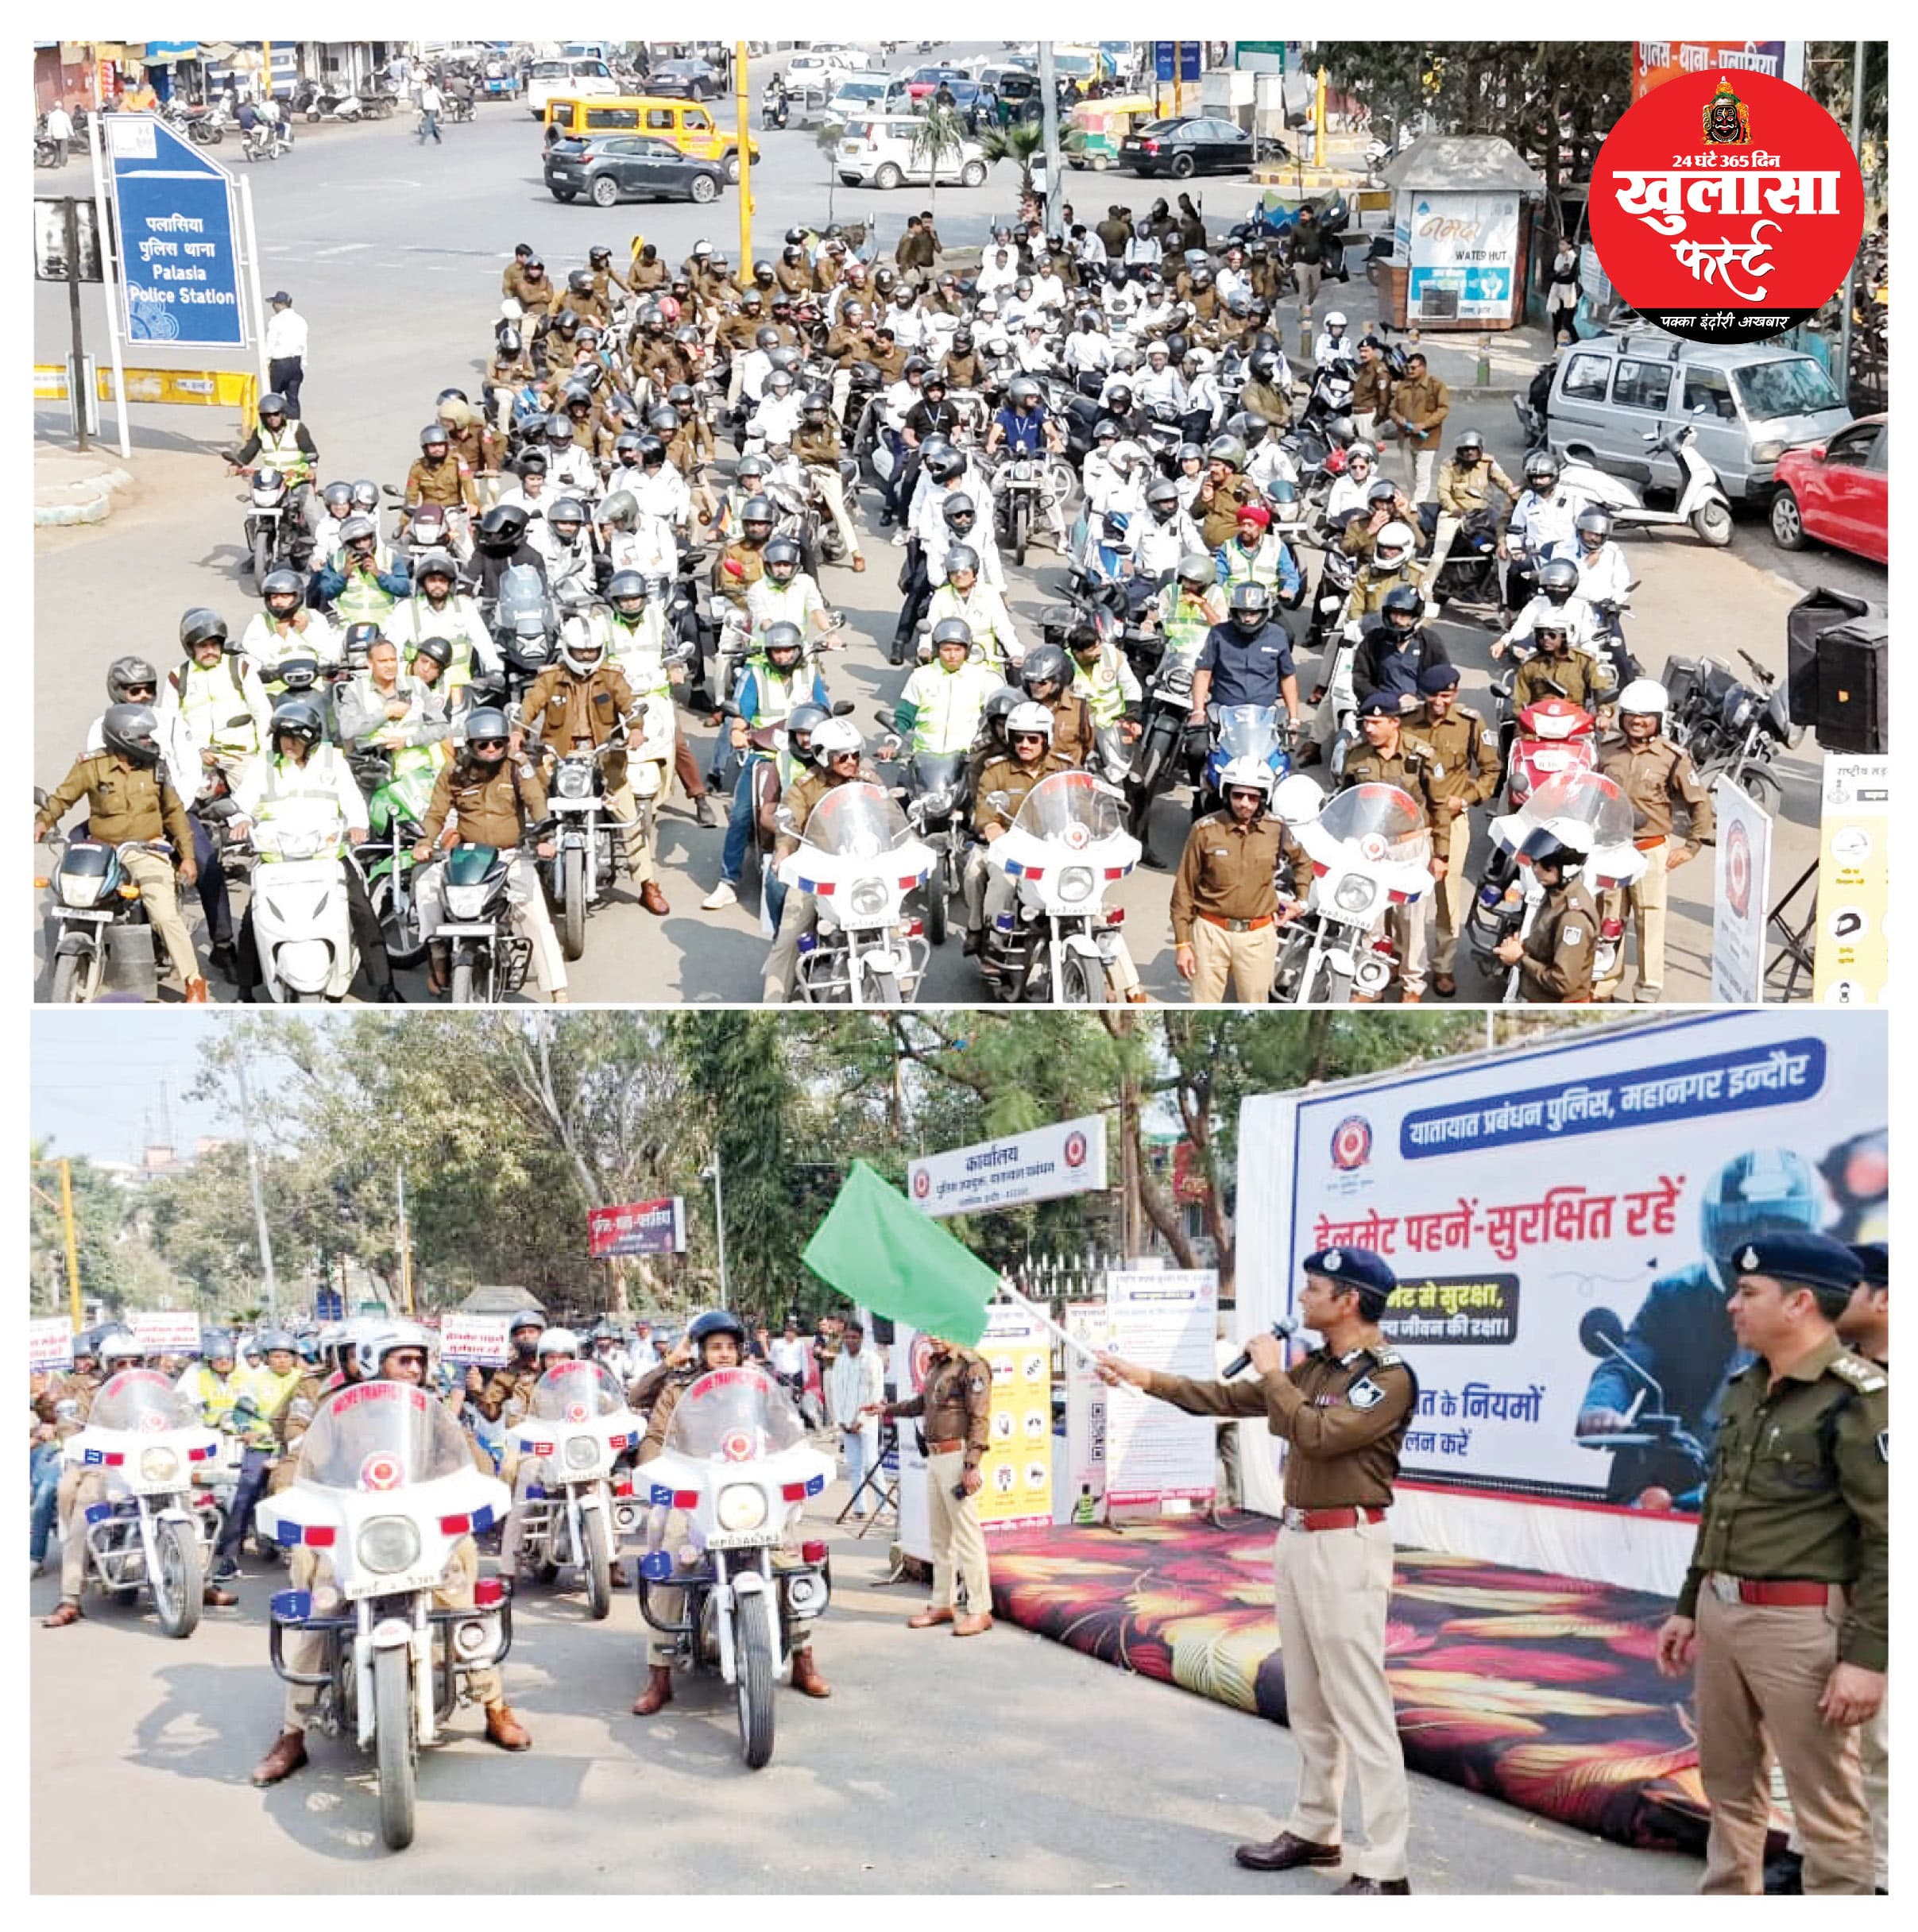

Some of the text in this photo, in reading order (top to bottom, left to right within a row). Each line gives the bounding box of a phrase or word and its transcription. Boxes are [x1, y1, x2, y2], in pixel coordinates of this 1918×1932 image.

[145, 213, 203, 233] पलासिया
[138, 237, 215, 261] पुलिस थाना
[1455, 250, 1507, 261] WATER HUT
[153, 265, 207, 280] Palasia
[130, 287, 235, 305] Police Station
[1409, 1049, 1812, 1145] यातायात प्रबंधन पुलिस, महानगर इन्दौर
[1313, 1208, 1398, 1254] हेलमेट
[1623, 1175, 1686, 1236] रहें
[1418, 1281, 1436, 1308] से
[1446, 1314, 1470, 1338] की
[1440, 1389, 1459, 1417] के
[1462, 1381, 1546, 1423] नियमों
[1440, 1428, 1472, 1457] करें
